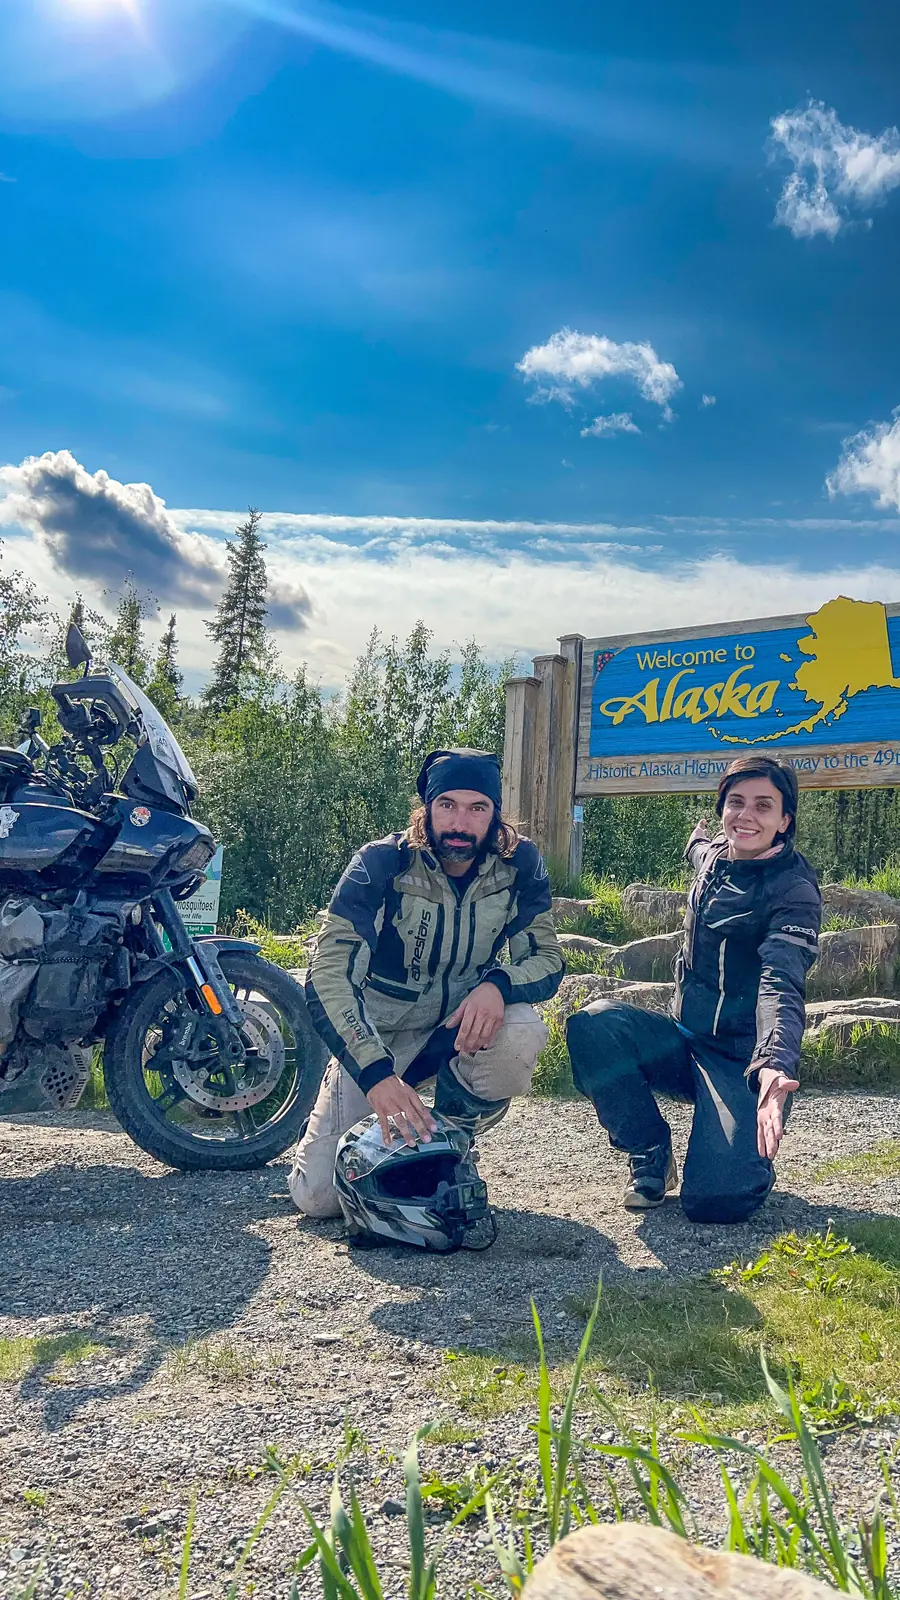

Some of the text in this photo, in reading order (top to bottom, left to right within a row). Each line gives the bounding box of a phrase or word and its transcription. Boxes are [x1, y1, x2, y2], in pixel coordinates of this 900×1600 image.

[637, 644, 755, 670] Welcome to
[600, 664, 780, 725] Alaska
[589, 749, 900, 780] Historic Alaska Highw eway to the 49t
